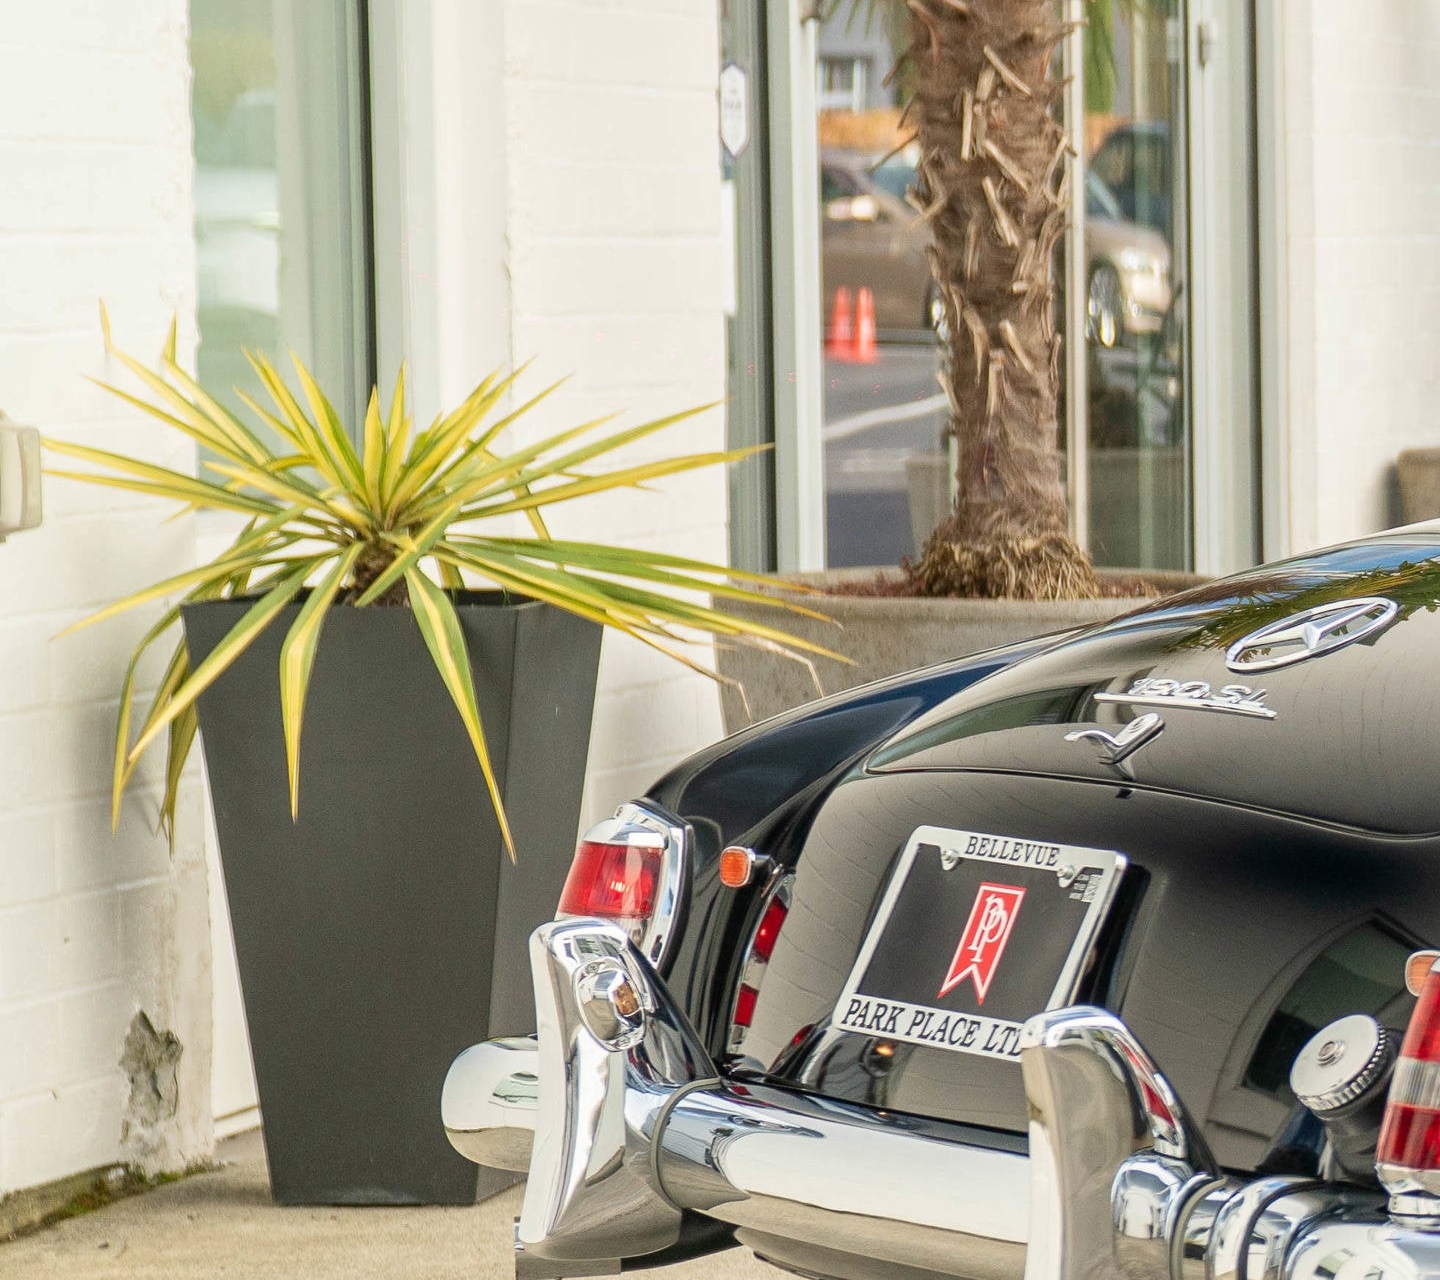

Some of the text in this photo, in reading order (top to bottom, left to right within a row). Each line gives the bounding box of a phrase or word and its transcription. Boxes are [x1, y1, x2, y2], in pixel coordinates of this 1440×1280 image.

[965, 836, 1060, 867] BELLEVUE
[841, 998, 905, 1033] PARK
[906, 1008, 981, 1048] PLACE
